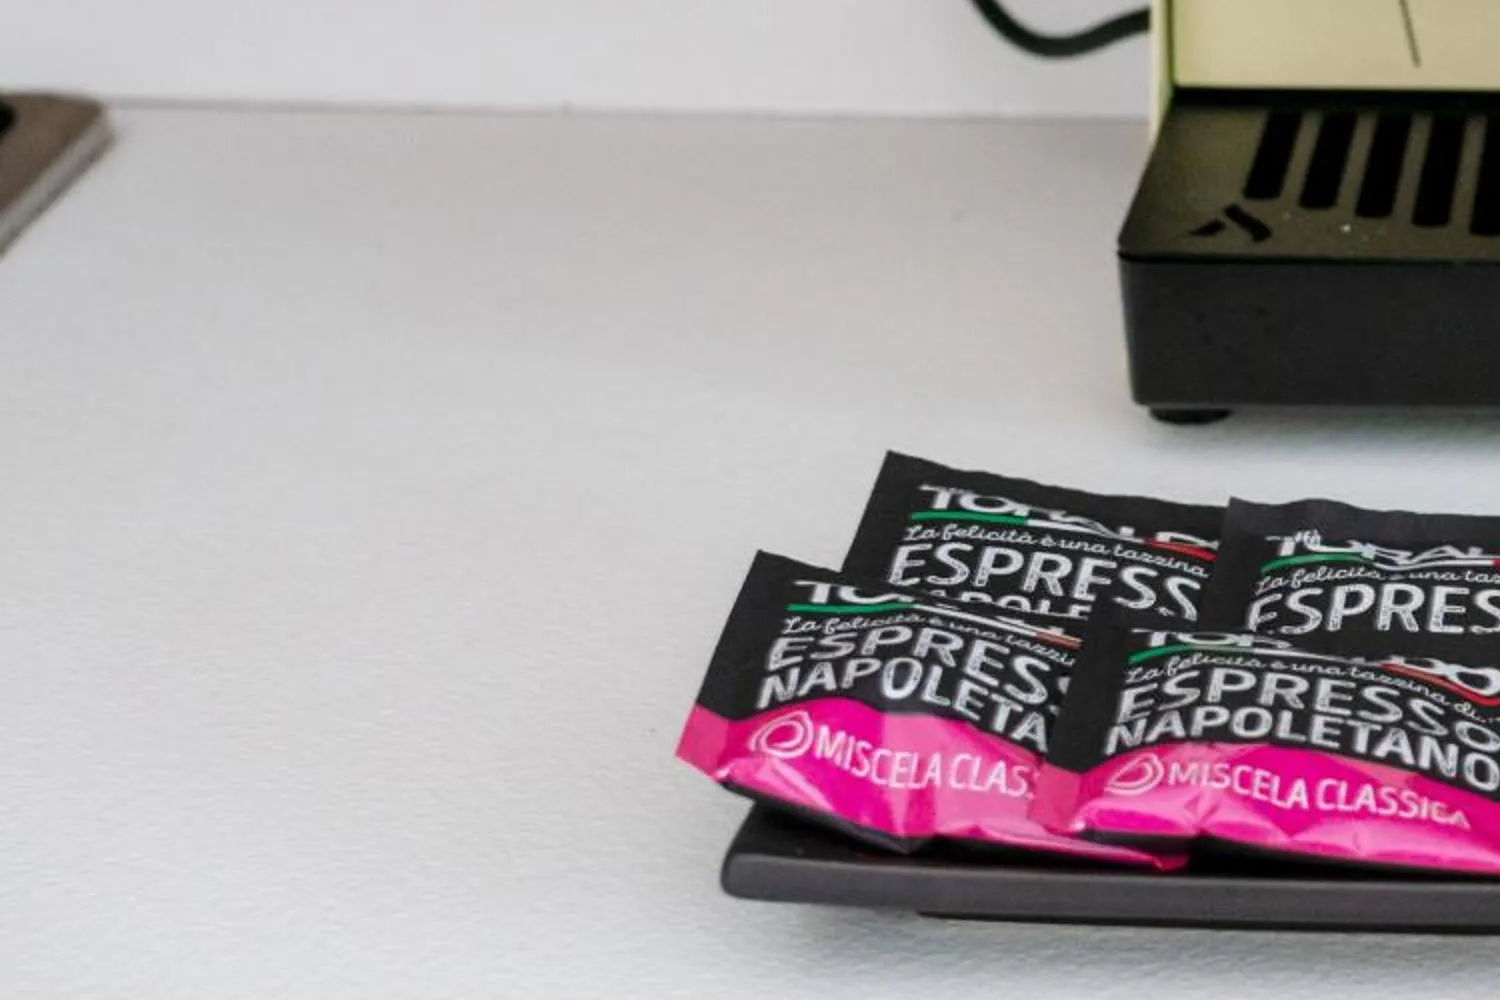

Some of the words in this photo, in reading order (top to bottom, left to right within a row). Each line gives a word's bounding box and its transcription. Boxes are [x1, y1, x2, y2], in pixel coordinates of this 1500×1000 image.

[767, 625, 1071, 715] ESPRES
[814, 725, 941, 790] MISCELA
[949, 753, 1038, 799] CLAS
[1104, 705, 1500, 792] NAPOLETANO
[1168, 762, 1309, 809] MISCELA
[1315, 778, 1471, 830] CLASSICA
